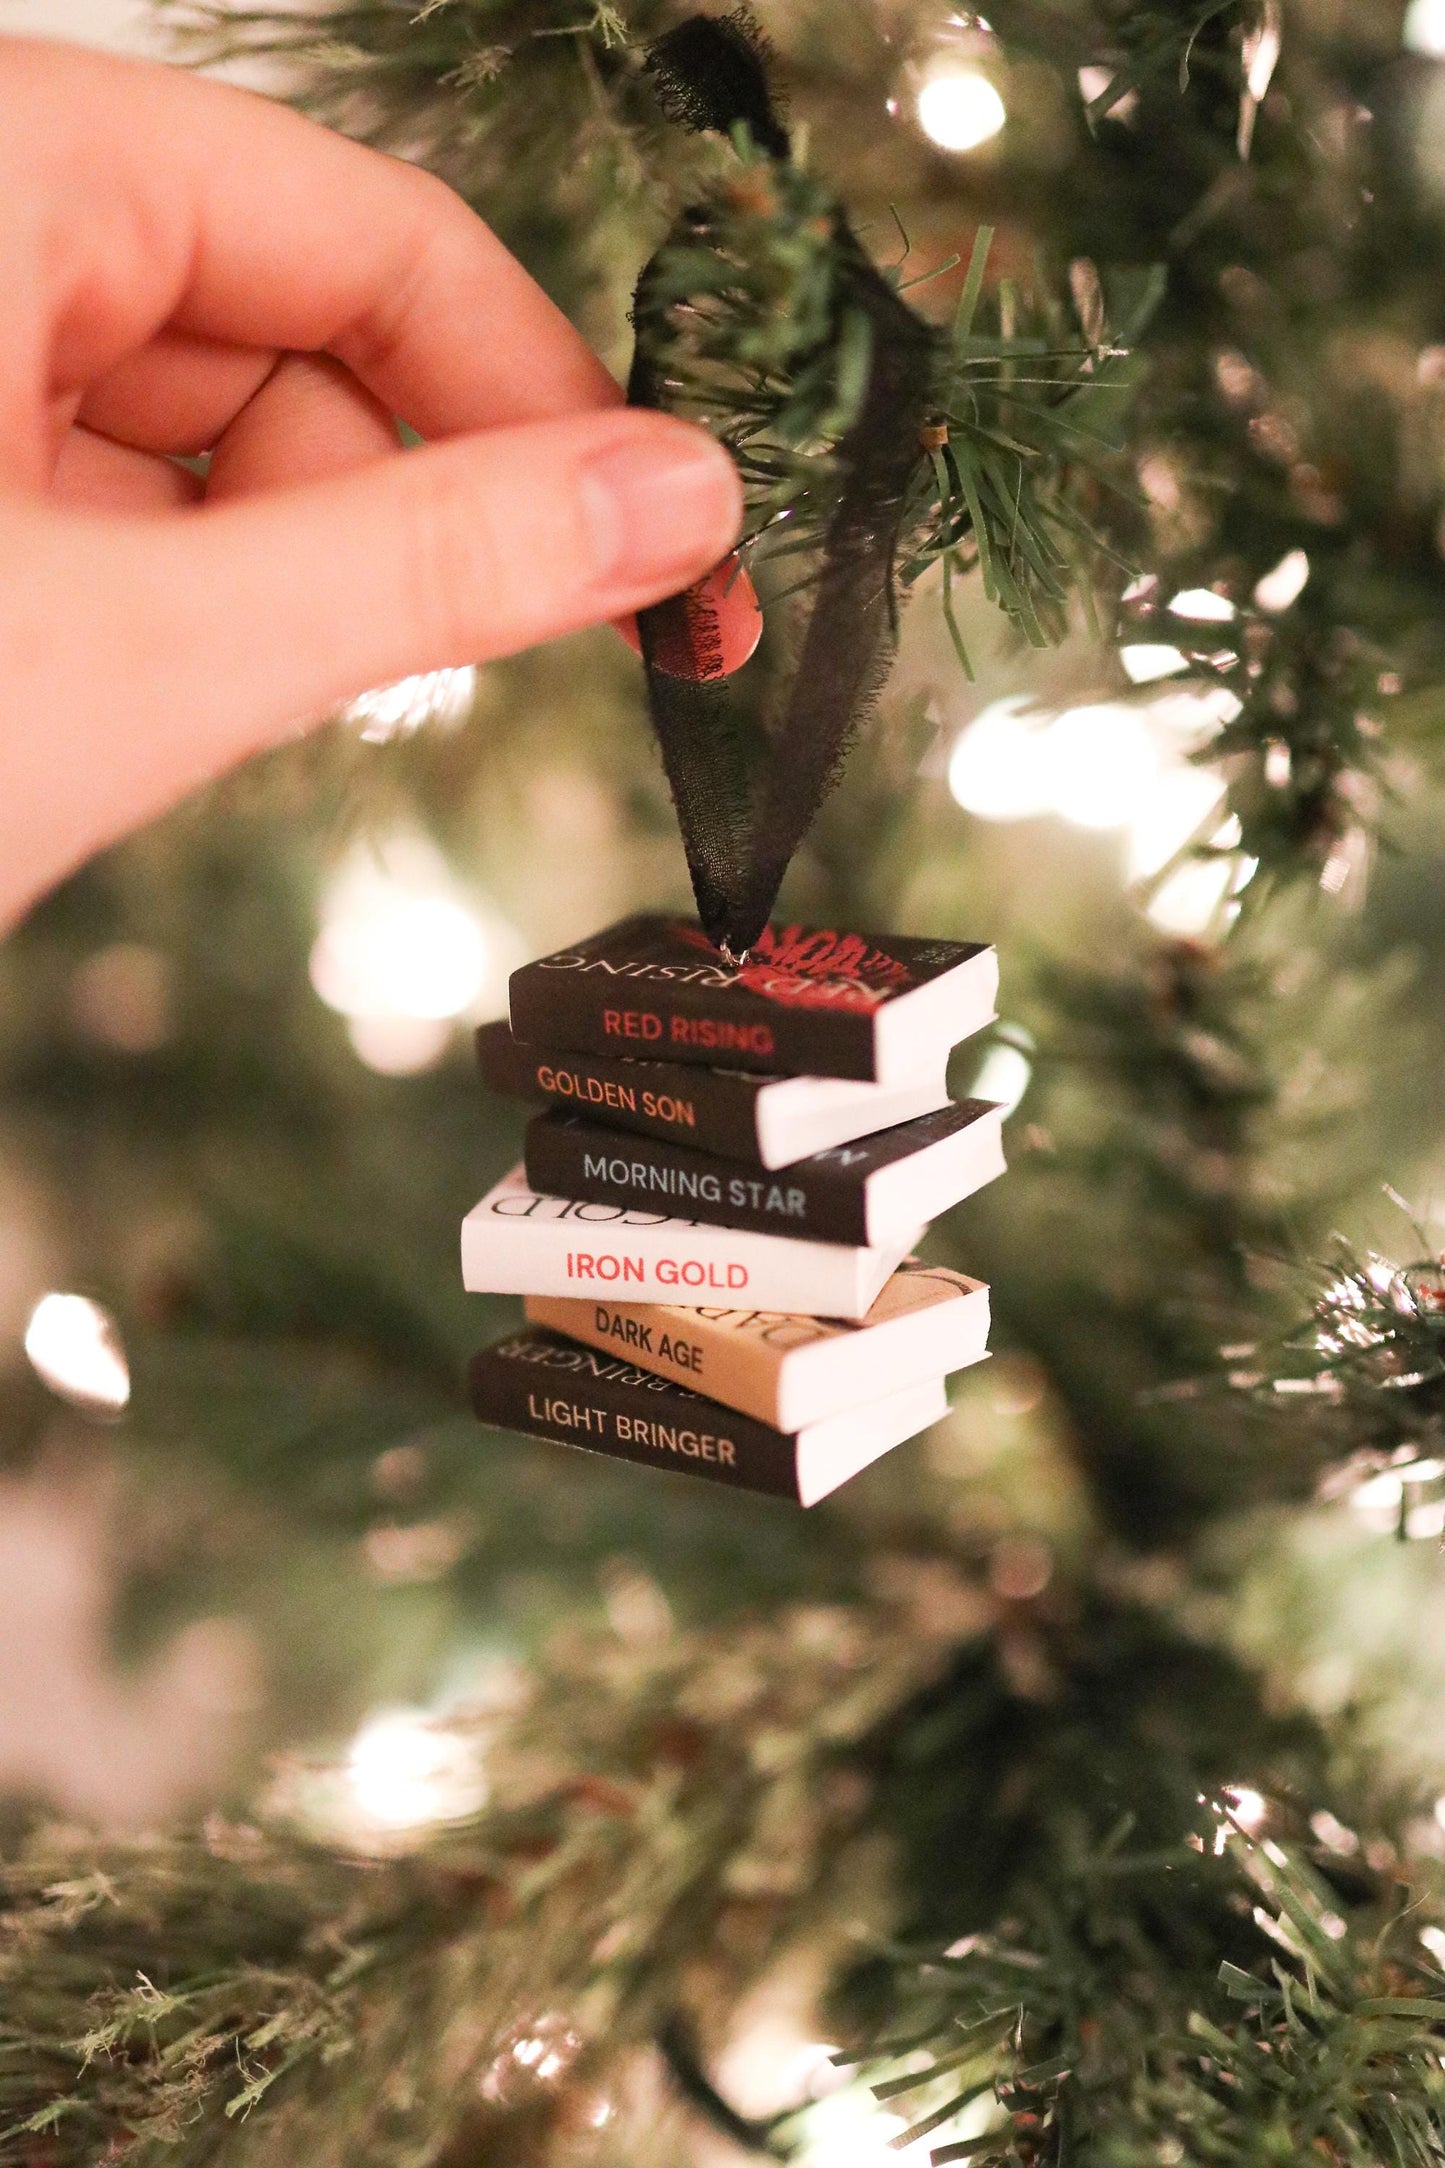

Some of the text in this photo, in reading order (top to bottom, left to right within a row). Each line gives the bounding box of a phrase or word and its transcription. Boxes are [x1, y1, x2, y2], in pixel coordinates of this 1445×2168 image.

[539, 955, 746, 989] RISING
[603, 1009, 775, 1056] RED RISING
[537, 1065, 695, 1127] GOLDEN SON
[584, 1153, 806, 1217] MORNING STAR
[567, 1252, 749, 1289] IRON GOLD
[595, 1305, 704, 1374] DARK AGE
[529, 1394, 736, 1466] LIGHT BRINGER
